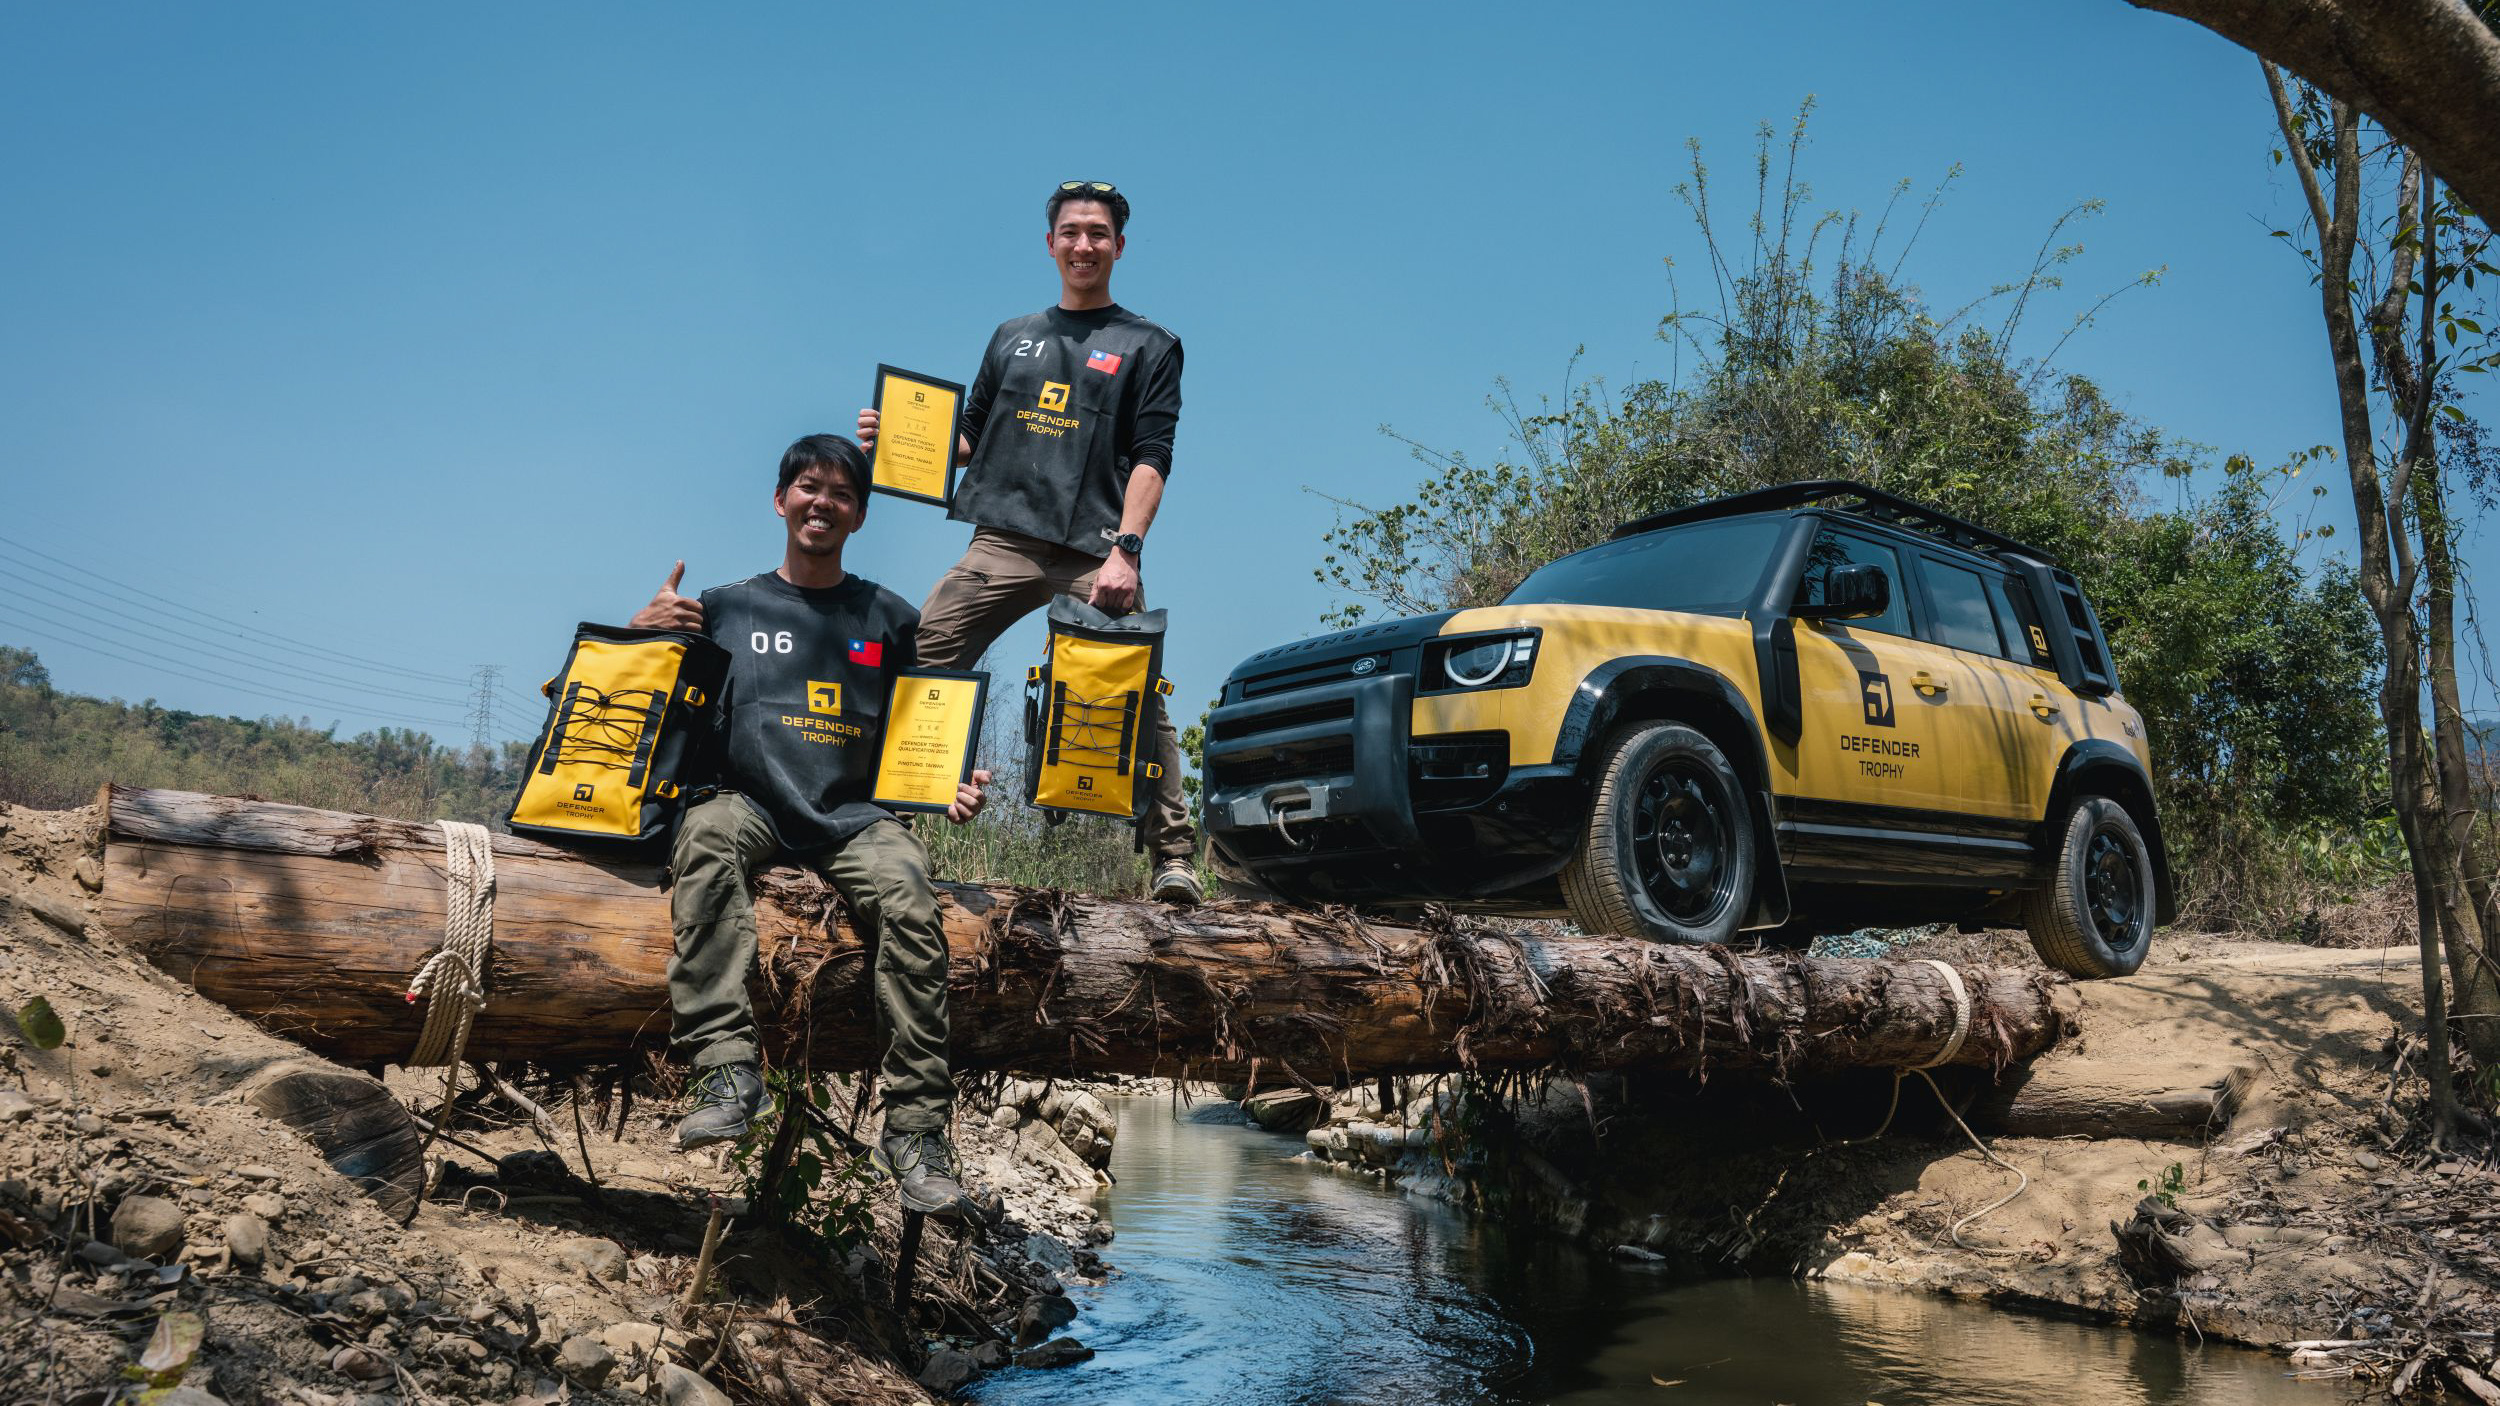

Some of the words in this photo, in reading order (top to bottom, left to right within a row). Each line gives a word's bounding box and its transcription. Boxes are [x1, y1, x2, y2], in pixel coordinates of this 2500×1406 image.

[1014, 339, 1045, 358] 21
[1016, 410, 1080, 429] DEFENDER
[1026, 422, 1065, 438] TROPHY
[751, 630, 793, 654] 06
[1253, 625, 1400, 662] DEFENDER
[782, 715, 862, 738] DEFENDER
[801, 731, 847, 748] TROPHY
[1840, 734, 1920, 758] DEFENDER
[1859, 760, 1905, 779] TROPHY
[1065, 789, 1103, 799] DEFENDER
[556, 801, 605, 814] DEFENDER
[566, 810, 594, 820] TROPHY
